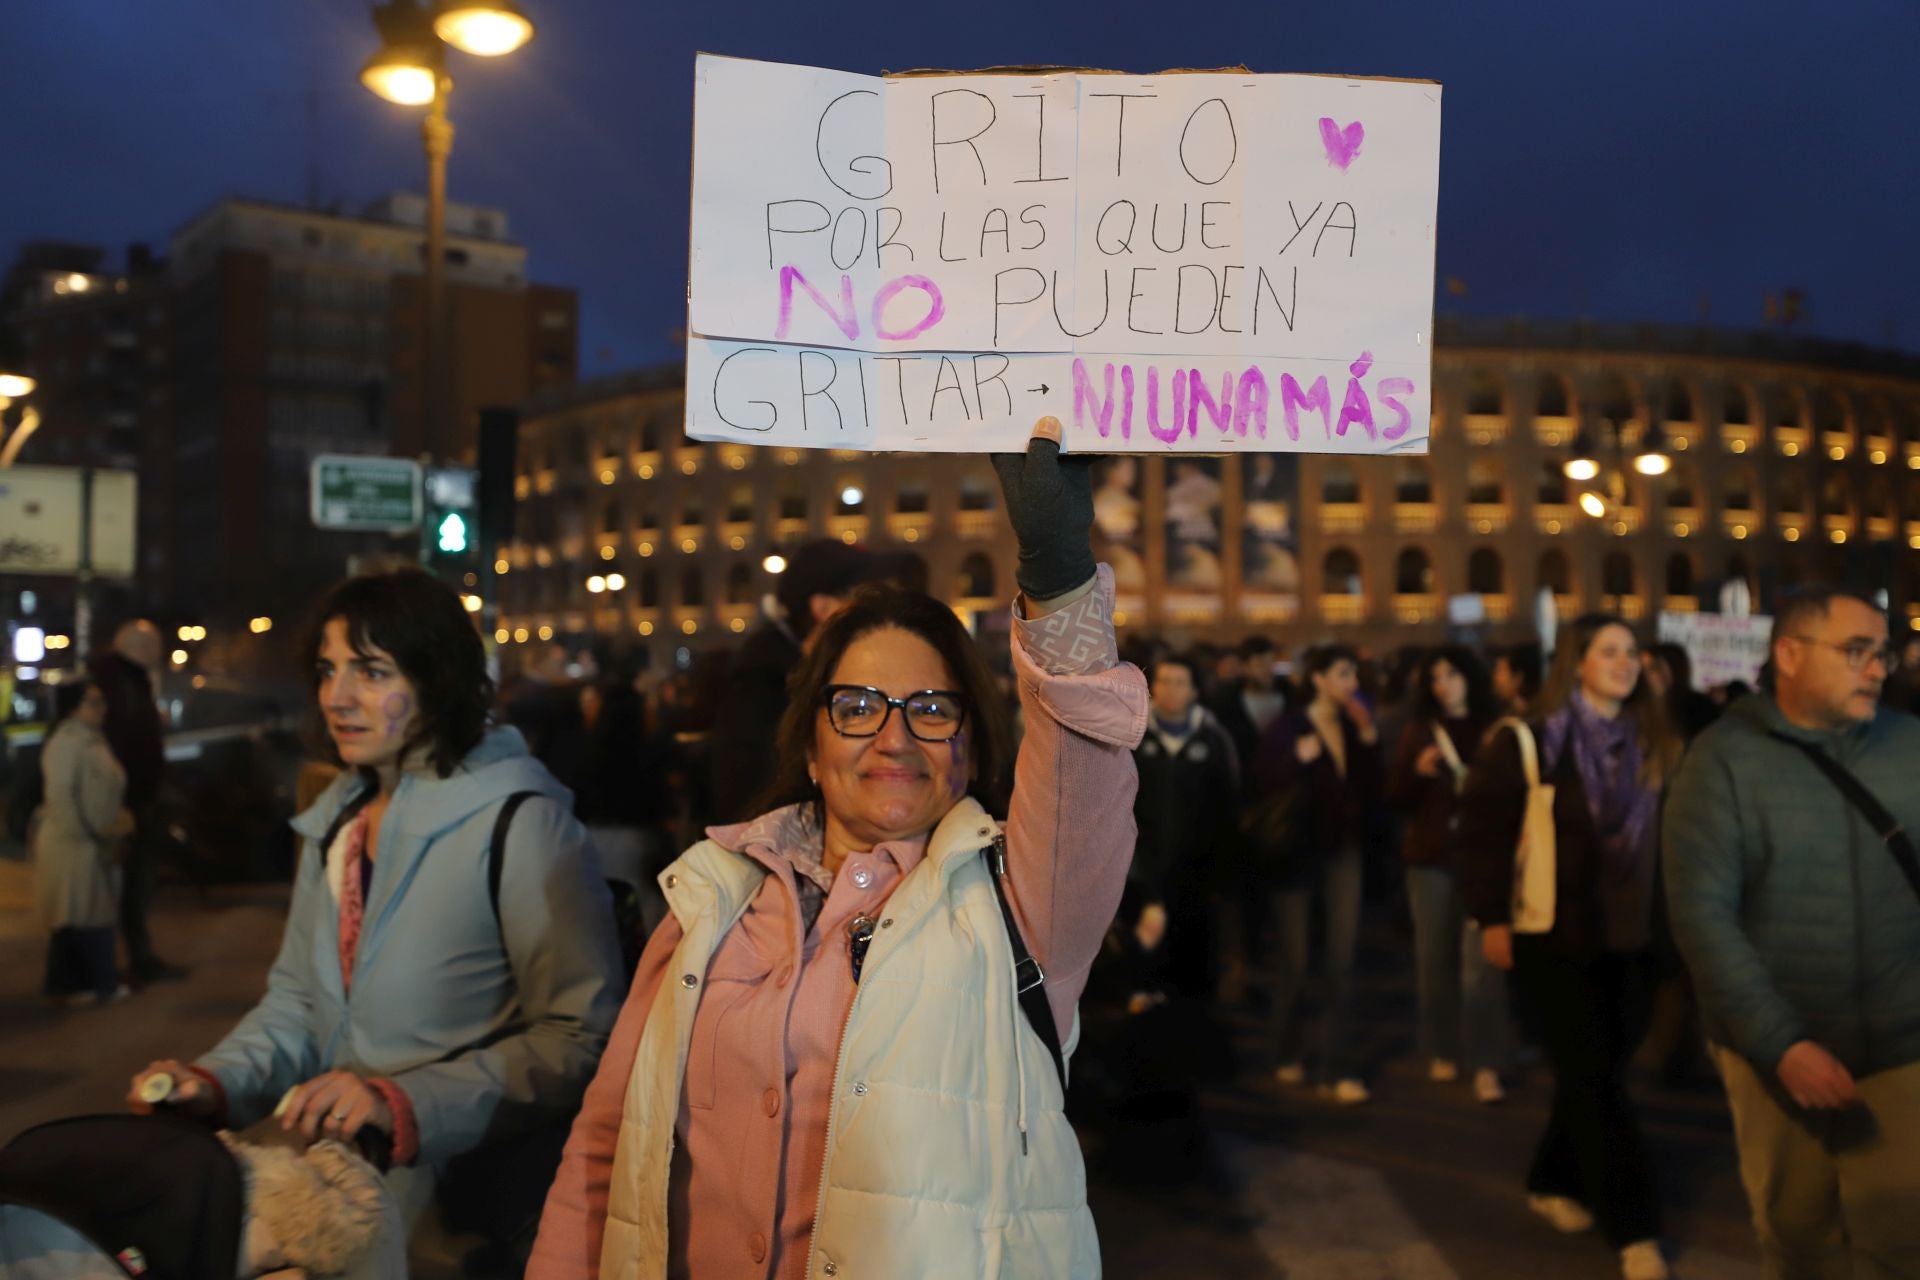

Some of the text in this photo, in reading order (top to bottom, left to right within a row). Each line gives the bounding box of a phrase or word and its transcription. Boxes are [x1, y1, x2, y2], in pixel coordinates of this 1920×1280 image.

[815, 88, 1238, 200] GRITO
[766, 199, 1357, 270] POR LAS QUE YA
[775, 263, 1299, 347] NO PUEDEN
[713, 348, 1012, 432] GRITAR
